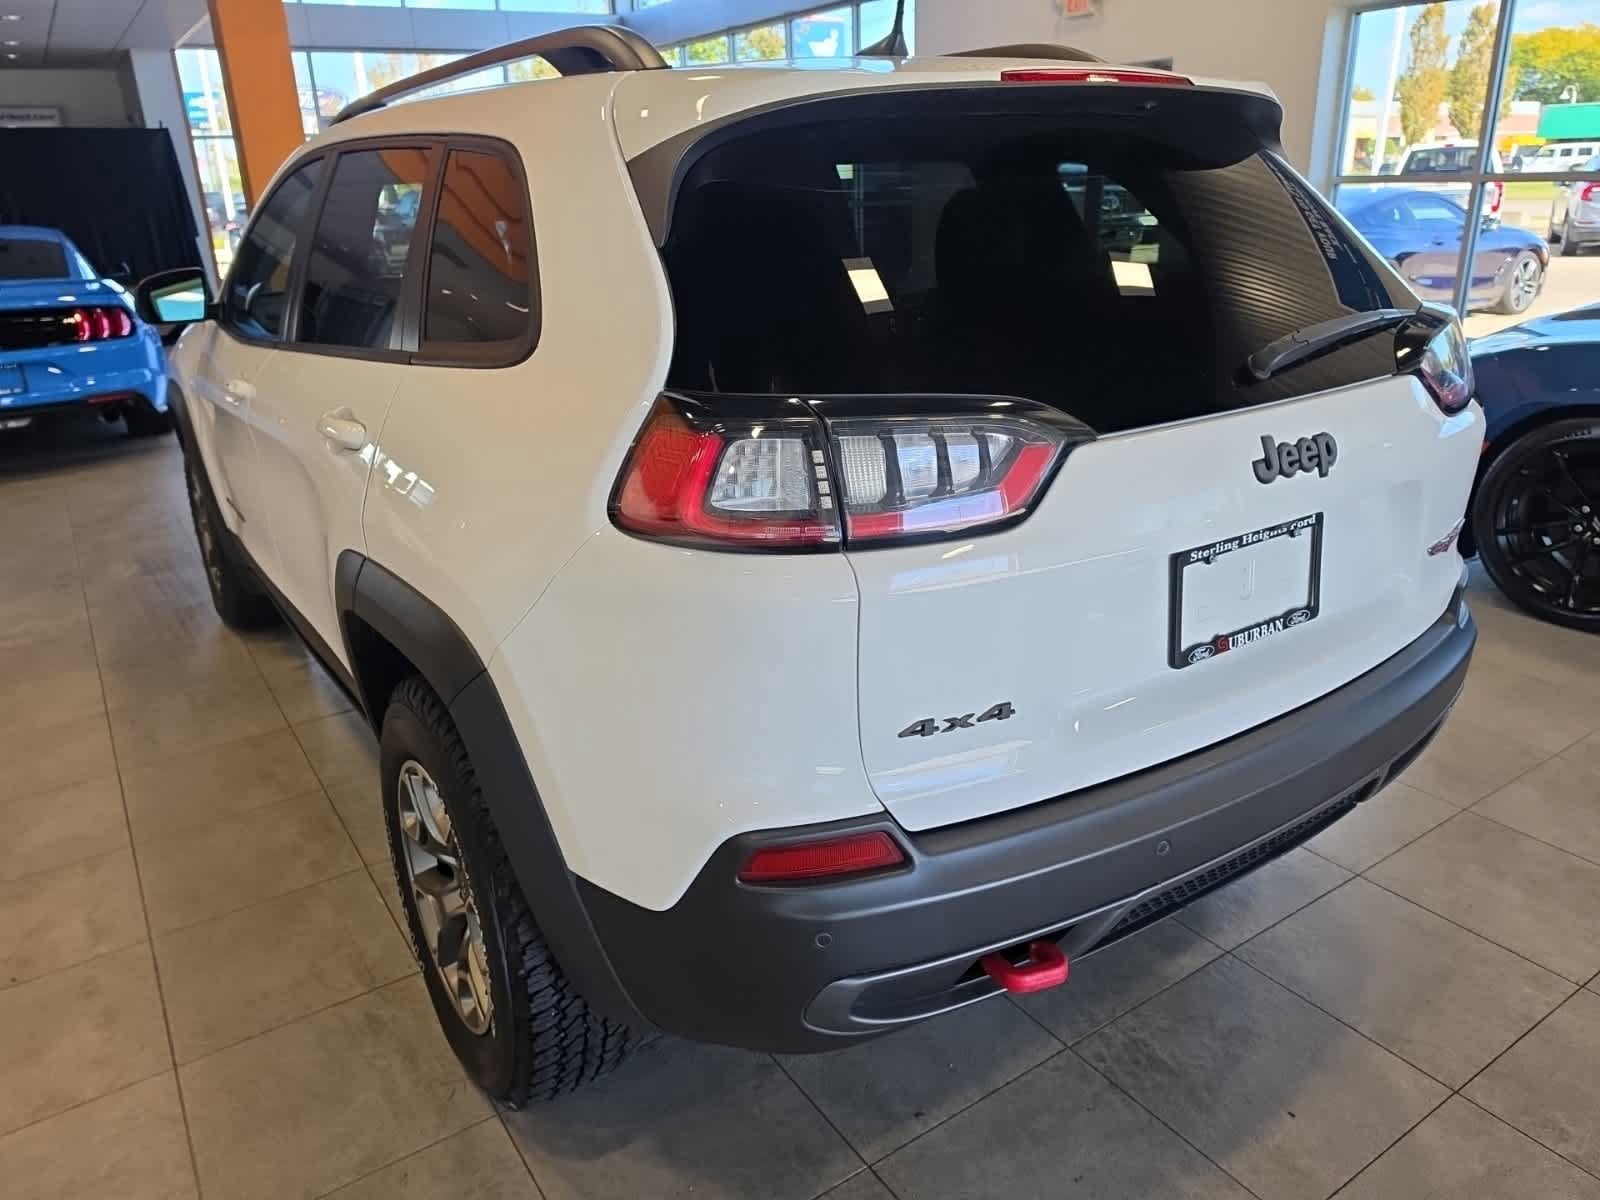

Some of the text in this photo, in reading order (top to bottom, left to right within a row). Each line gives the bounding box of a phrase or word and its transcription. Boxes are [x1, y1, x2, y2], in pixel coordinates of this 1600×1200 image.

[1252, 431, 1338, 485] Jeep
[1190, 538, 1240, 562] Sterling
[1217, 618, 1284, 651] SUBURBAN
[897, 701, 1017, 739] 4x4
